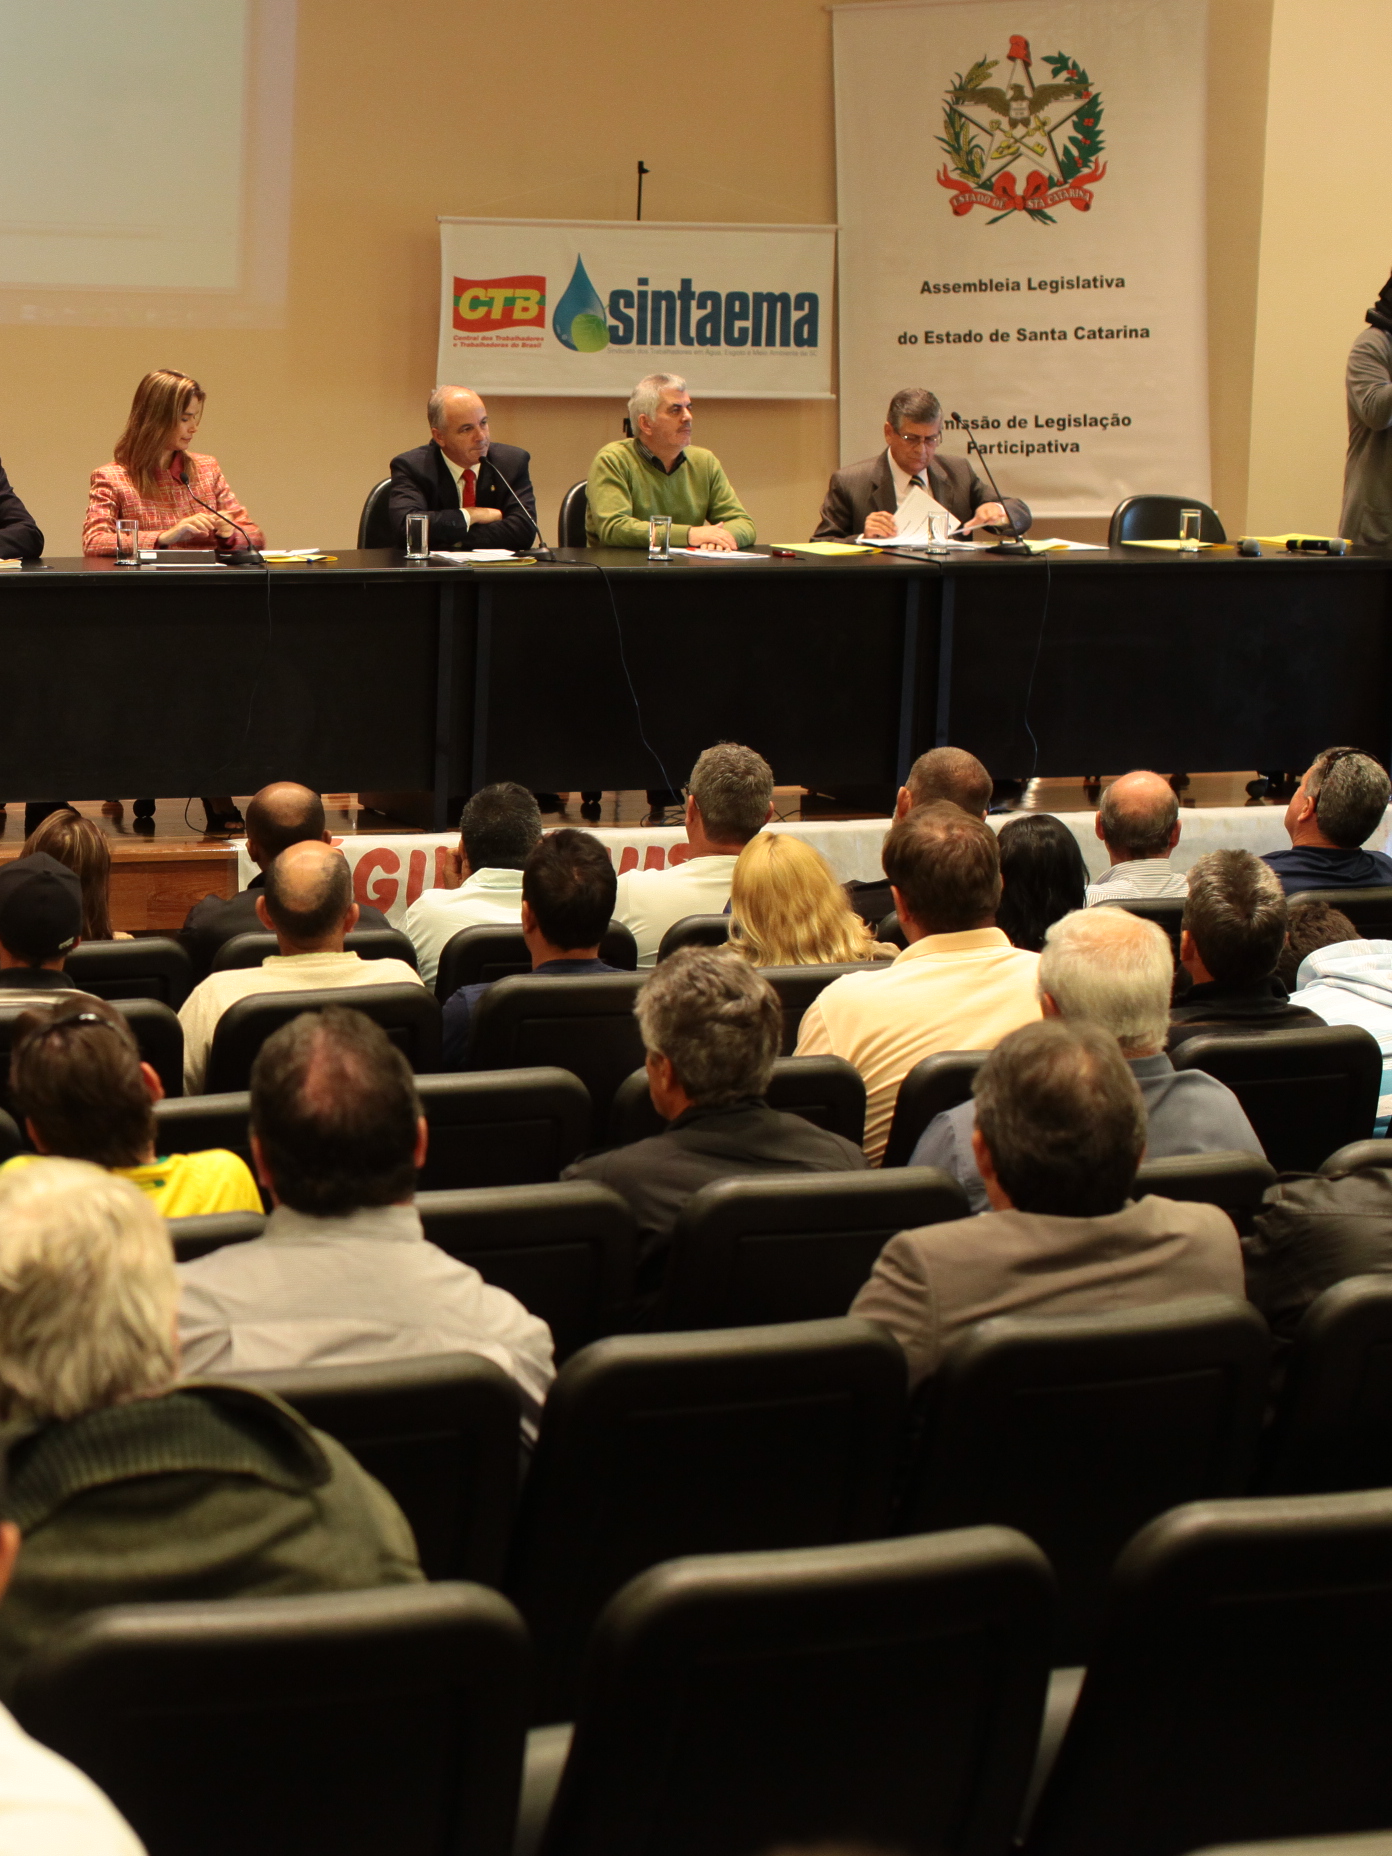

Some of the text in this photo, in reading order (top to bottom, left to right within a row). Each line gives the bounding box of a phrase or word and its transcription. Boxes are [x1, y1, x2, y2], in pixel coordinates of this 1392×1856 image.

[953, 193, 991, 206] ESTADO
[1047, 188, 1090, 204] CATARINA
[919, 275, 1126, 295] Assembleia Legislativa
[459, 287, 541, 320] CTB
[608, 277, 820, 348] sintaema
[897, 325, 1150, 346] do Estado de Santa Catarina
[944, 413, 1132, 432] missão de Legislação
[967, 439, 1080, 457] Participativa
